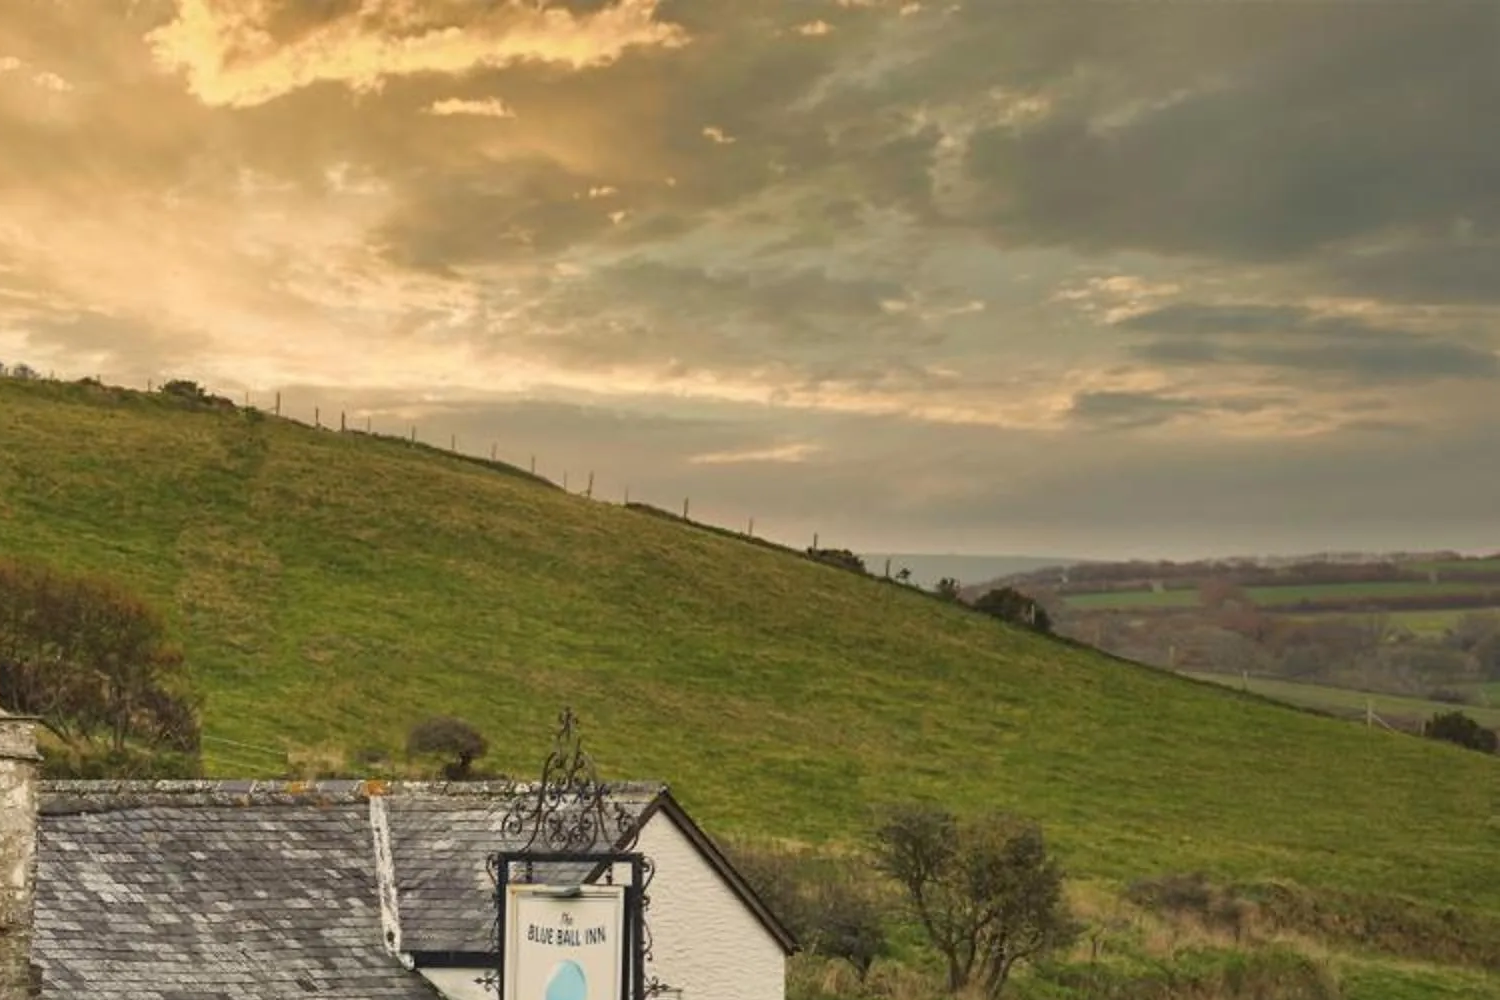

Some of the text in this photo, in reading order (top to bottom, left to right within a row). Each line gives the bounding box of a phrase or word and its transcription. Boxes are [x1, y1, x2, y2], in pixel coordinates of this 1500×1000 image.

[527, 923, 607, 947] BLUE BALL INN
